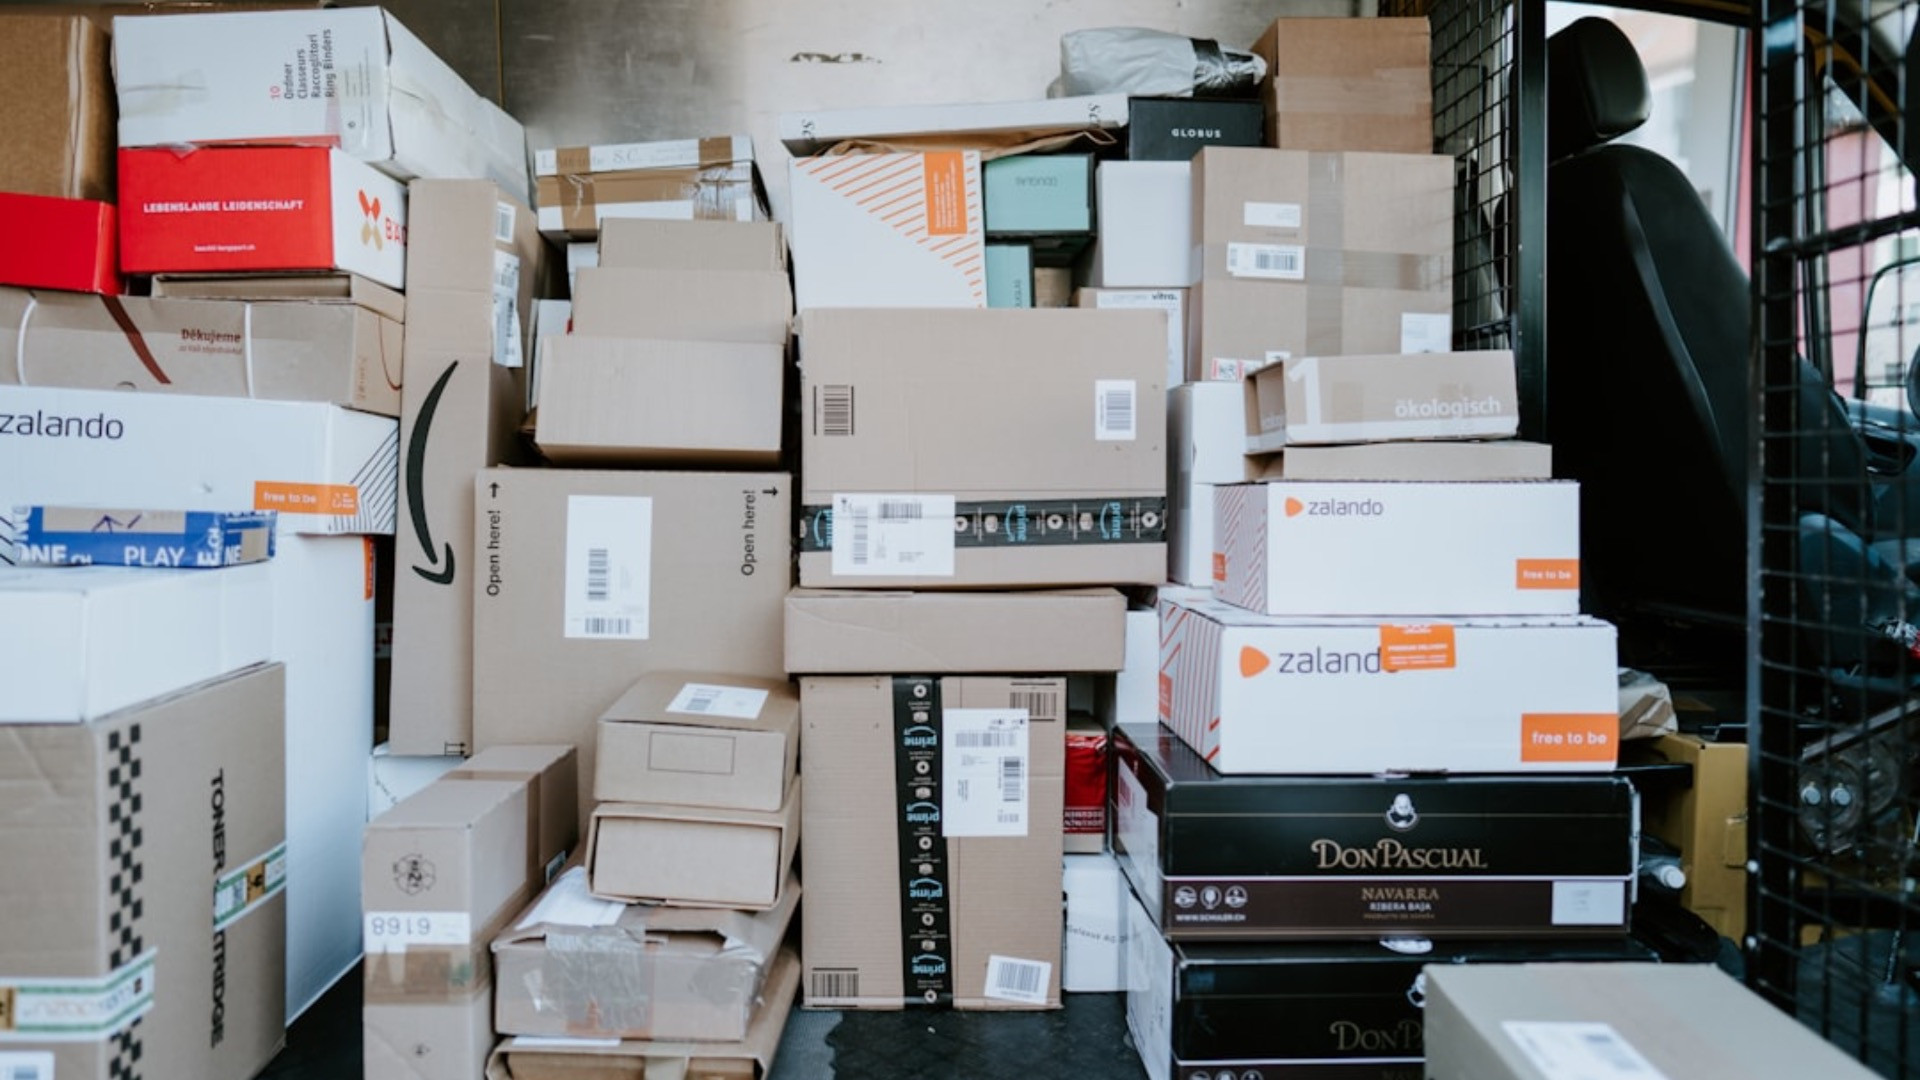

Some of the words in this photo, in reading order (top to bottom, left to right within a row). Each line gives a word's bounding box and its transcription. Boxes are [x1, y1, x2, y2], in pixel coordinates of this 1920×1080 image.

[322, 29, 333, 69] Binders
[297, 49, 307, 99] Classeurs
[306, 34, 321, 98] Raccoglitori
[269, 86, 280, 98] 10
[284, 64, 294, 99] Ordner
[325, 73, 336, 97] Ring
[1171, 128, 1221, 138] GLOBUS
[143, 201, 220, 213] LEBENSLANGE
[222, 199, 303, 212] LEIDENSCHAFT
[1393, 397, 1501, 419] ökologisch
[0, 409, 124, 440] zalando
[263, 491, 285, 503] free
[1308, 498, 1384, 516] zalando
[742, 489, 756, 529] here!
[487, 510, 501, 550] here!
[1015, 504, 1029, 542] prime
[1109, 502, 1124, 539] prime
[124, 546, 185, 567] PLAY
[742, 531, 757, 576] Open
[486, 554, 502, 596] Open
[1522, 570, 1543, 579] free
[1545, 570, 1556, 579] to
[1558, 570, 1572, 579] be
[1278, 646, 1398, 674] zaland
[903, 735, 938, 748] prime
[1531, 732, 1563, 745] free
[1567, 732, 1583, 745] to
[1587, 732, 1607, 745] be
[211, 768, 226, 874] TONER
[906, 811, 940, 824] prime
[909, 888, 943, 900] prime
[1361, 887, 1439, 900] NAVARRA
[1369, 902, 1406, 911] RIBERA
[1407, 902, 1432, 911] BAJA
[911, 963, 947, 976] prime
